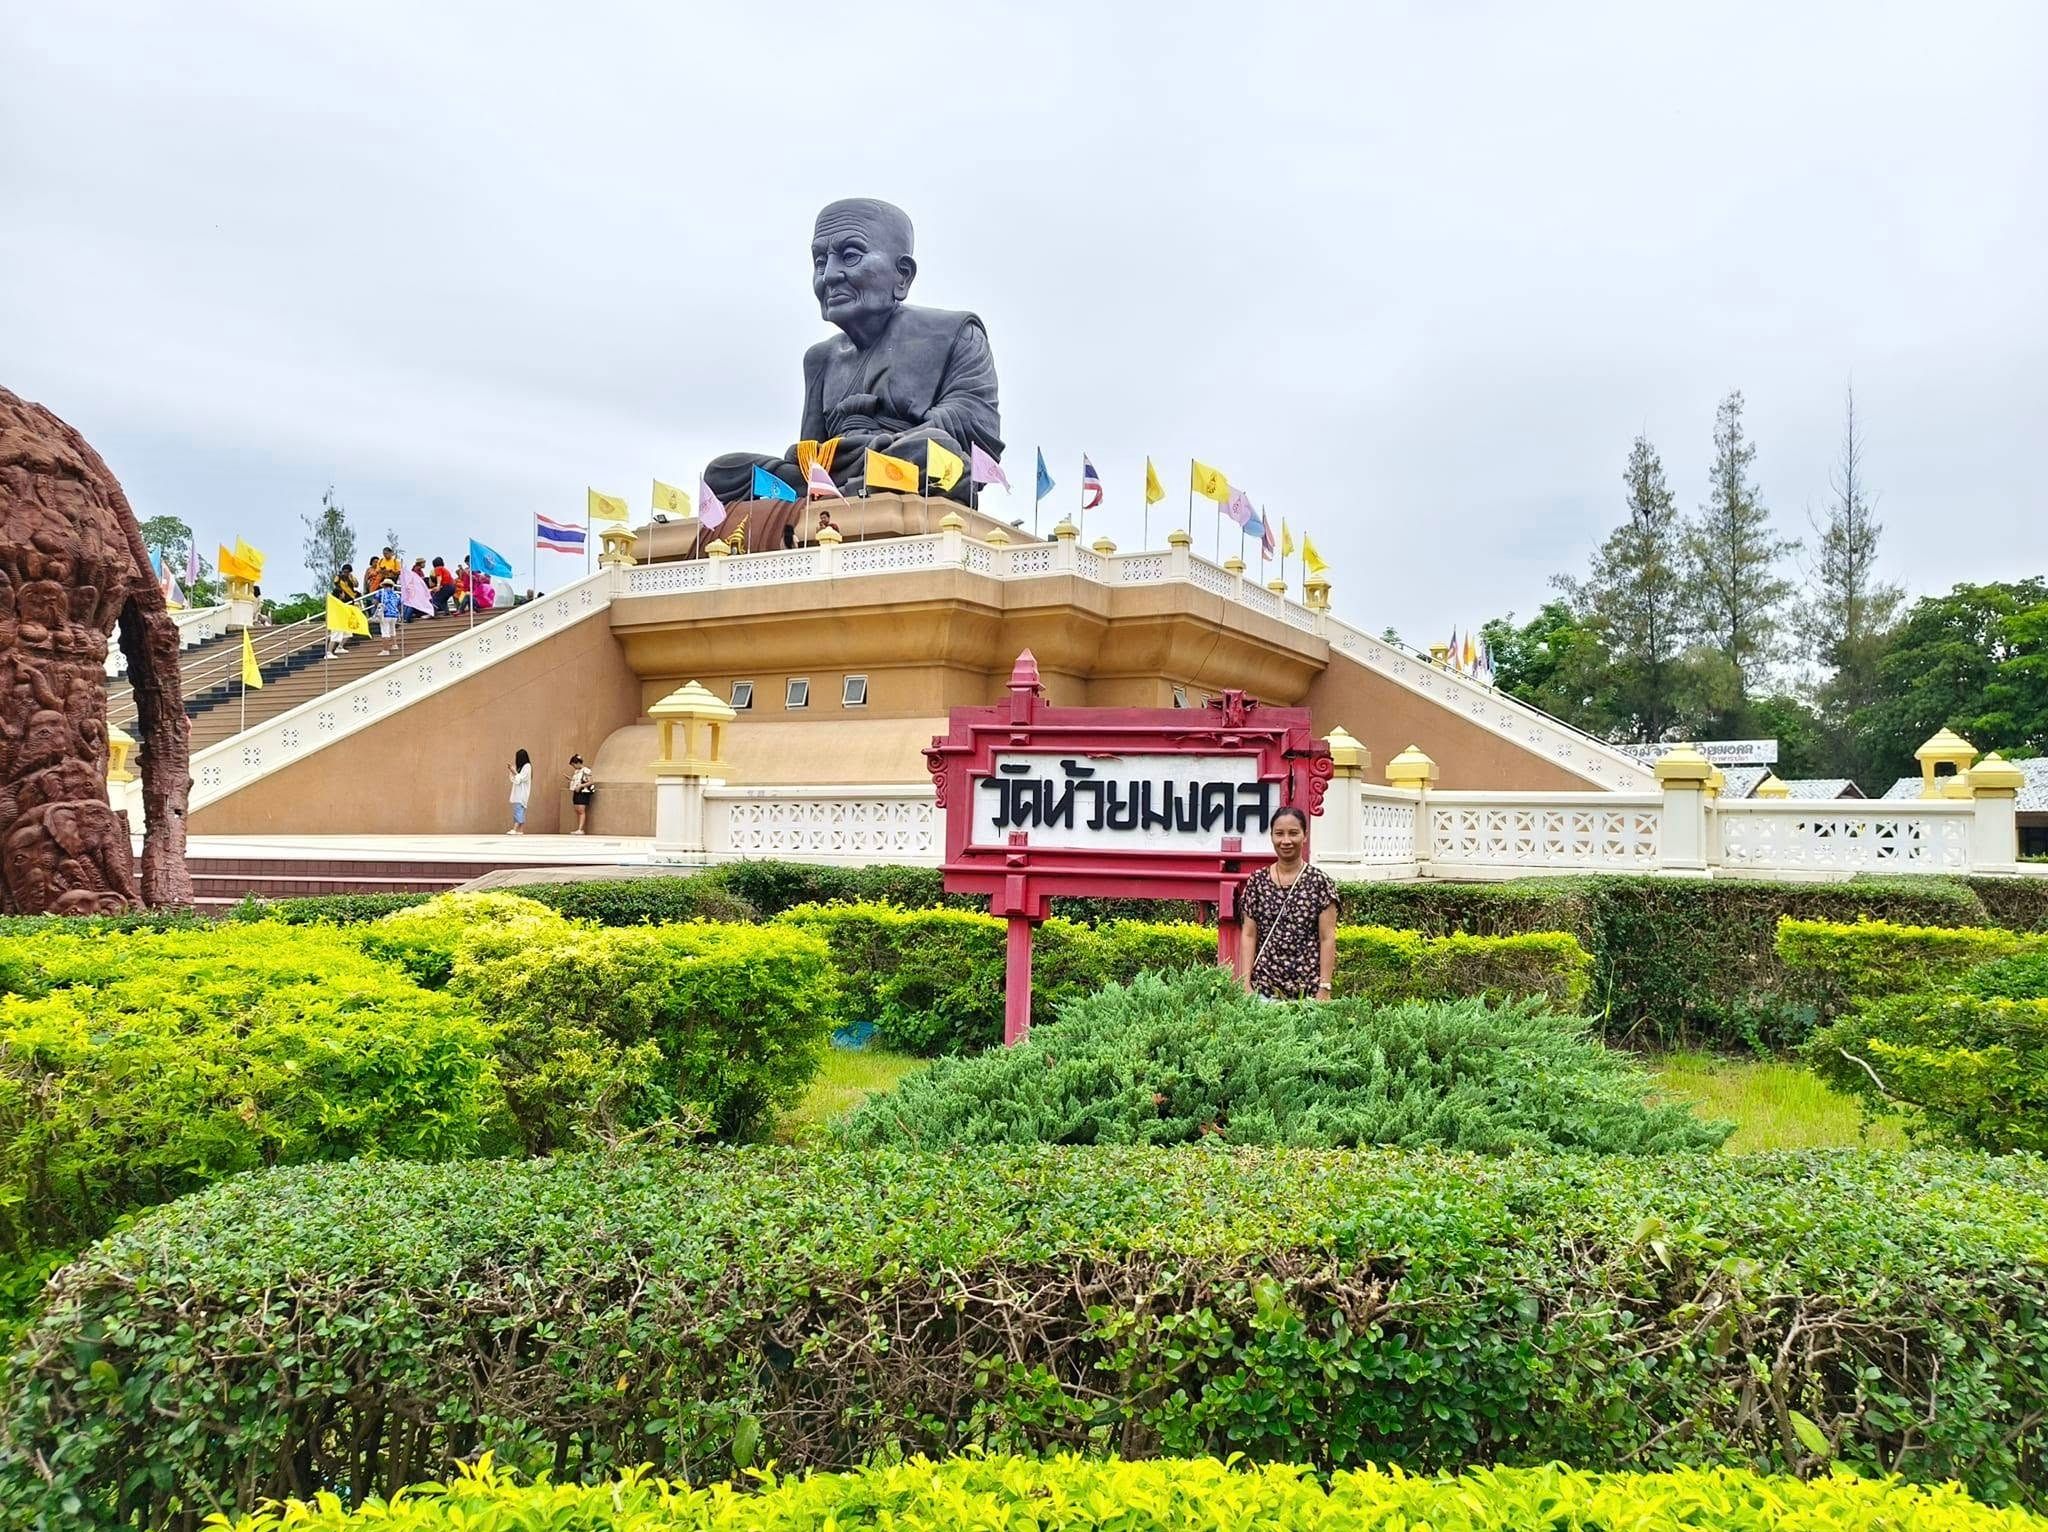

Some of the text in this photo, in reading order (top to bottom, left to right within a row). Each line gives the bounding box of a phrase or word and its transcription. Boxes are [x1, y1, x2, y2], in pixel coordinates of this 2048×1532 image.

[981, 759, 1270, 833] วัดห้วยมงคล
